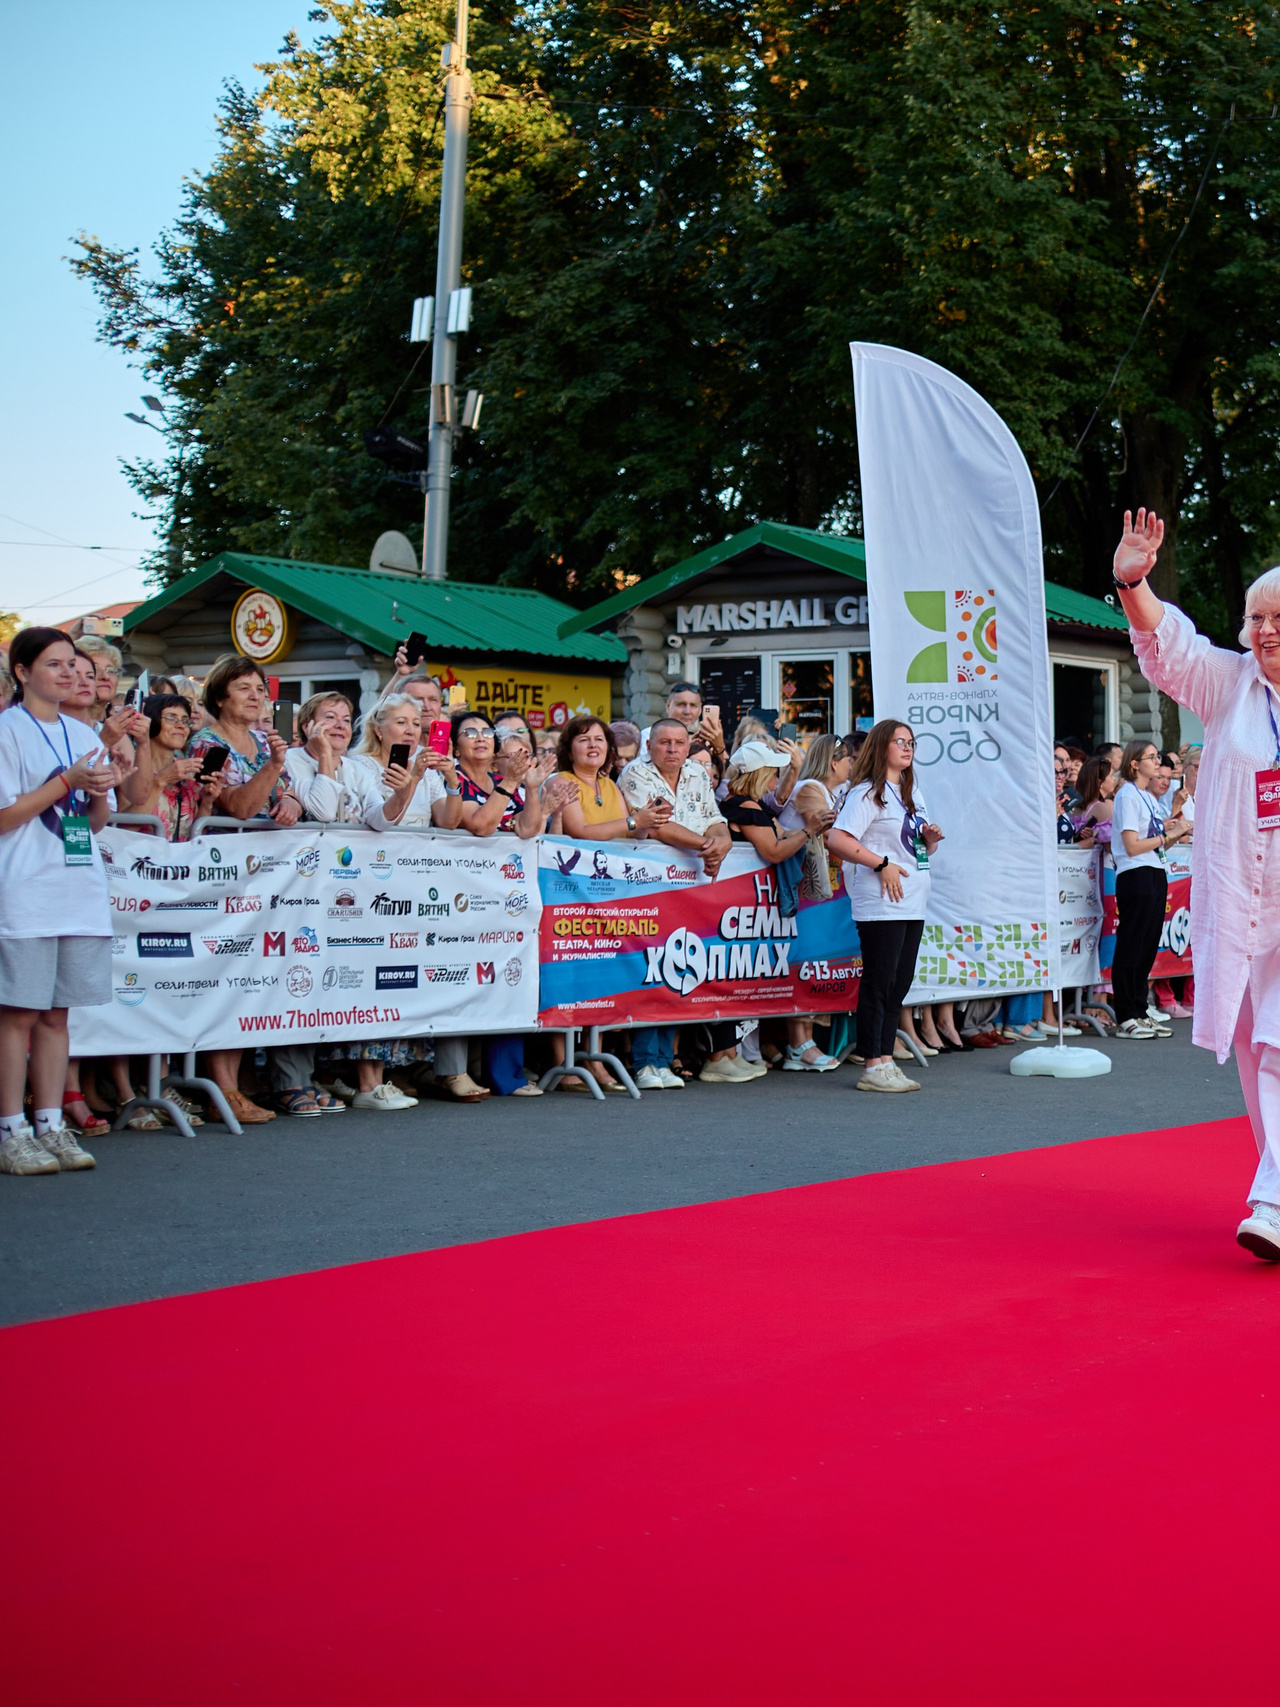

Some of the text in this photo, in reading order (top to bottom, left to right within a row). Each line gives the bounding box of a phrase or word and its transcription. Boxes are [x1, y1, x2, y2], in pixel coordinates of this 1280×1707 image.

[676, 598, 830, 634] MARSHALL
[475, 679, 544, 706] ДАЙТЕ
[296, 850, 320, 870] МОРЕ
[198, 865, 238, 882] ВЯТИЧ
[626, 867, 646, 885] ТЕАТР
[554, 883, 579, 892] ТЕАТР
[753, 874, 778, 904] Н
[280, 898, 302, 906] Киров
[504, 893, 529, 910] МОРЕ
[327, 909, 363, 917] CHARUSHIN
[418, 903, 450, 916] ВЯТИЧ
[553, 906, 586, 916] ВТОРОЙ
[620, 907, 659, 917] ОТКРЫТЫЙ
[553, 918, 660, 937] ФЕСТИВАЛЬ
[141, 939, 188, 947] KIROV.RU
[438, 936, 459, 944] Киров
[478, 931, 515, 944] МАРИЯ
[552, 939, 622, 950] ТЕАТРА, КИНО
[561, 952, 617, 961] ЖУРНАЛИСТИКИ
[379, 971, 416, 980] KIROV.RU
[799, 960, 831, 981] 6-13
[810, 982, 847, 994] КИРОВ
[239, 1005, 400, 1032] www.7holmovfest.ru
